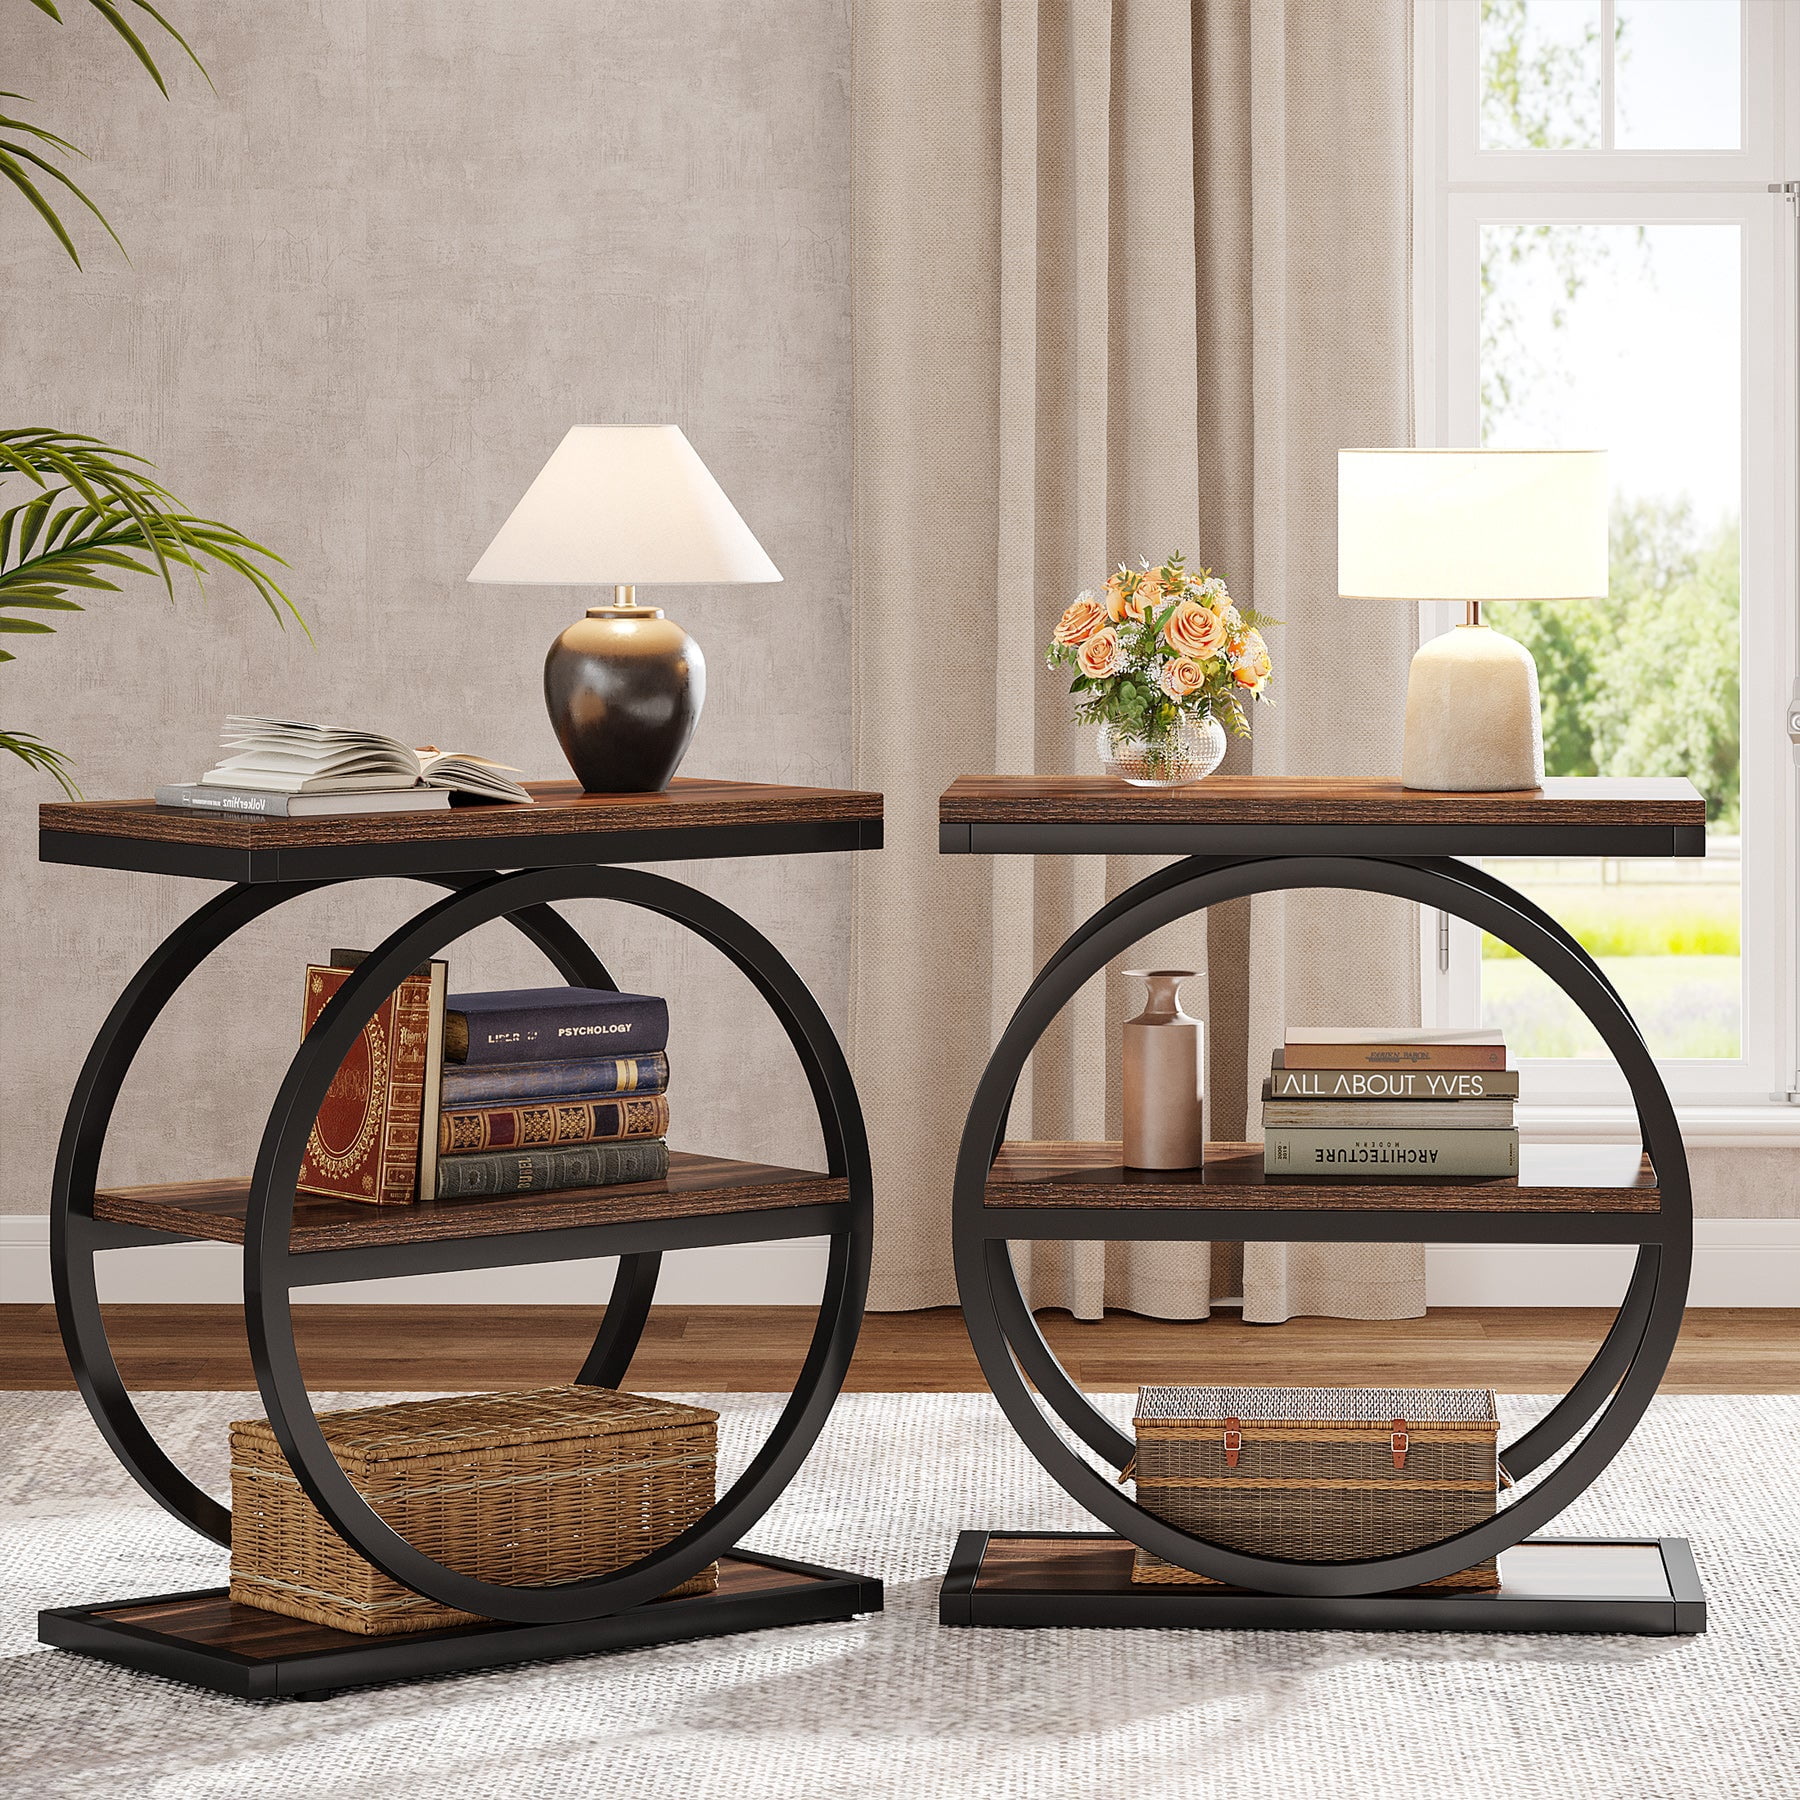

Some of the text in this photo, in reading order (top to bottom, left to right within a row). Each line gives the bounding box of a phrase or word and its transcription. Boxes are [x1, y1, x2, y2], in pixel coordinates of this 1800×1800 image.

[558, 1023, 632, 1037] PSYCHOLOGY
[1282, 1074, 1325, 1095] ALL
[1333, 1074, 1416, 1095] ABOUT
[1425, 1074, 1484, 1096] YVES
[1315, 1149, 1439, 1164] ARCHITECTURE
